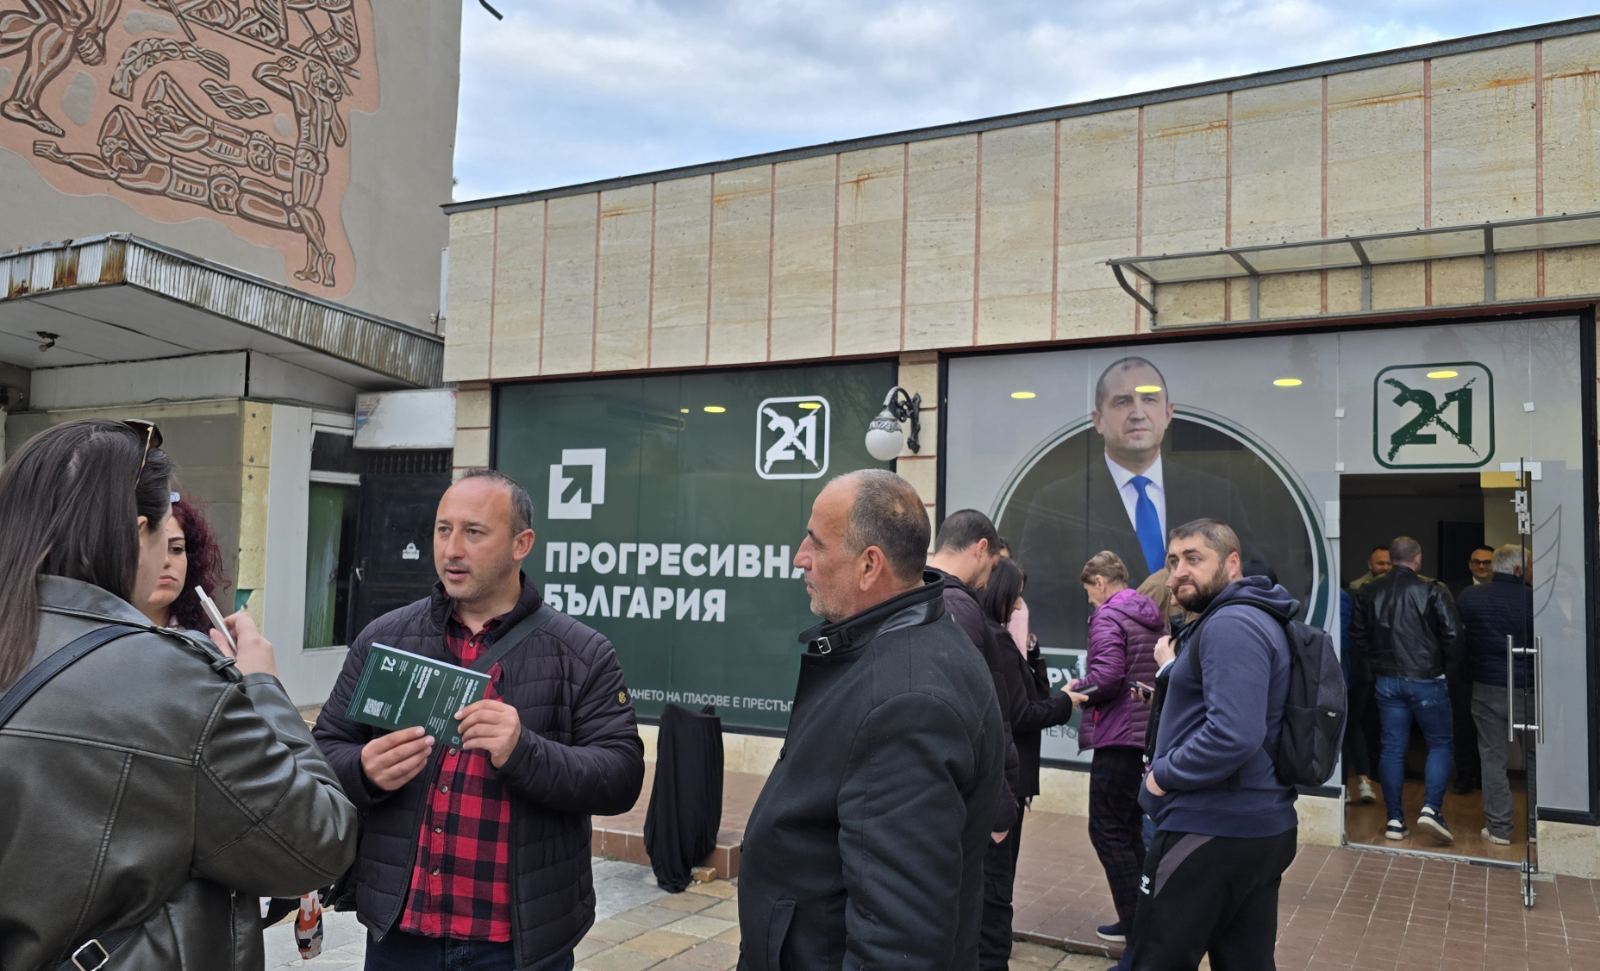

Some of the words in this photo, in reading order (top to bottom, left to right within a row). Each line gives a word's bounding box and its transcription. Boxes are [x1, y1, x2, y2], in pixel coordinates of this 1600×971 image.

[1388, 384, 1476, 451] 21
[765, 411, 818, 464] 21
[544, 584, 726, 622] БЪЛГАРИЯ
[381, 656, 396, 672] 21
[666, 691, 680, 703] НА
[683, 692, 730, 707] ГЛАСОВЕ
[733, 696, 740, 708] Е
